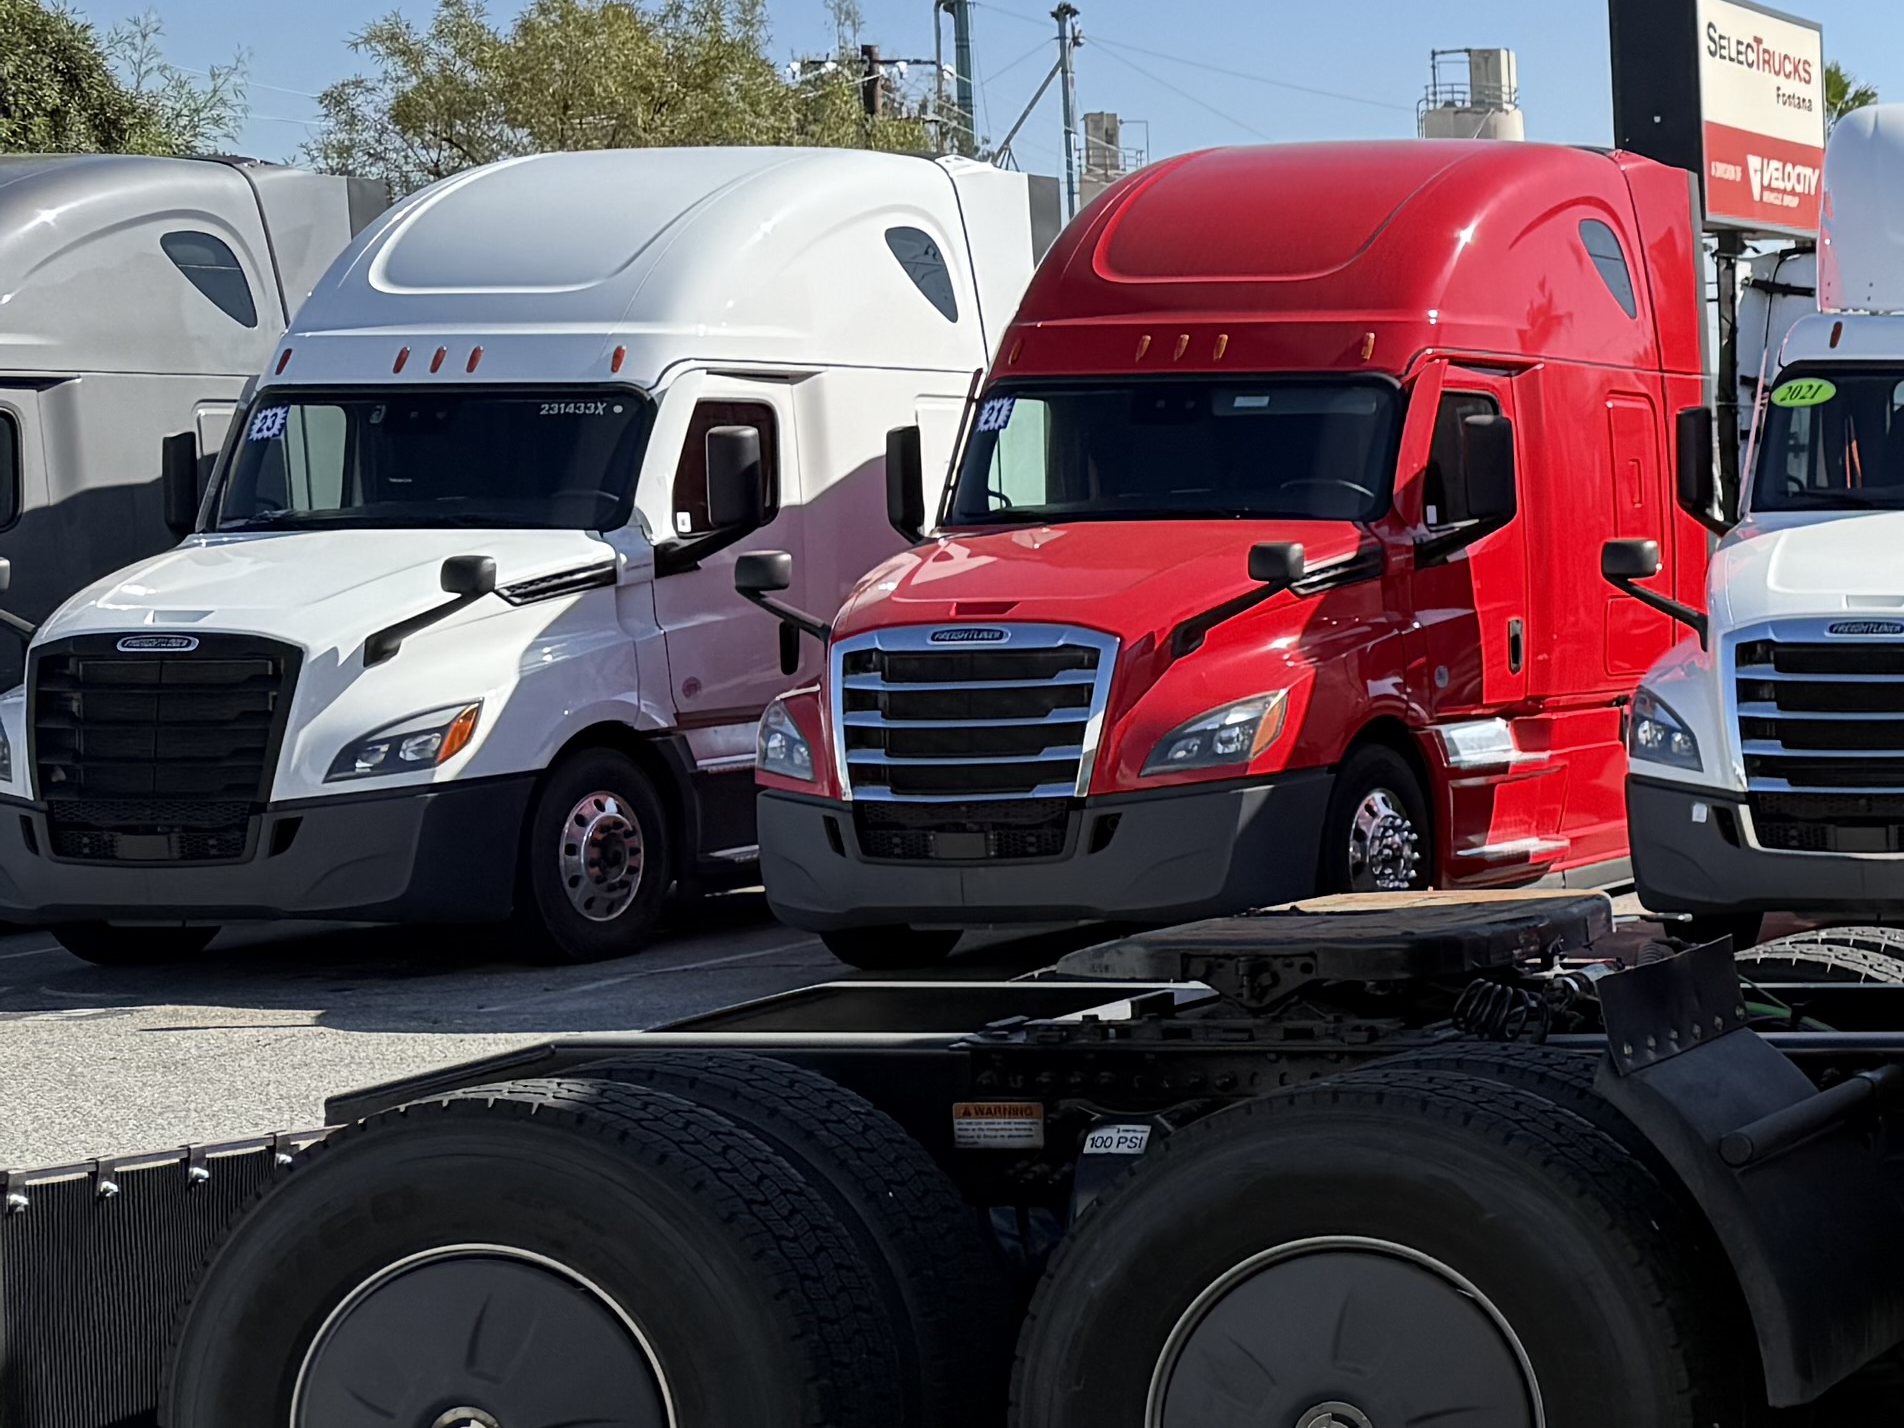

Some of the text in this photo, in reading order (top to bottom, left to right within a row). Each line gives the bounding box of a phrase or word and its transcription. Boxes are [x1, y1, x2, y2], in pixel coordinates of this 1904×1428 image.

[1706, 21, 1812, 85] SELECTRUCKS
[1762, 153, 1819, 196] VELOCITY
[1779, 384, 1823, 402] 2021
[256, 412, 278, 434] 23
[983, 403, 1004, 425] 21
[973, 1106, 1034, 1117] WARNING
[1090, 1136, 1144, 1149] 100 PSI
